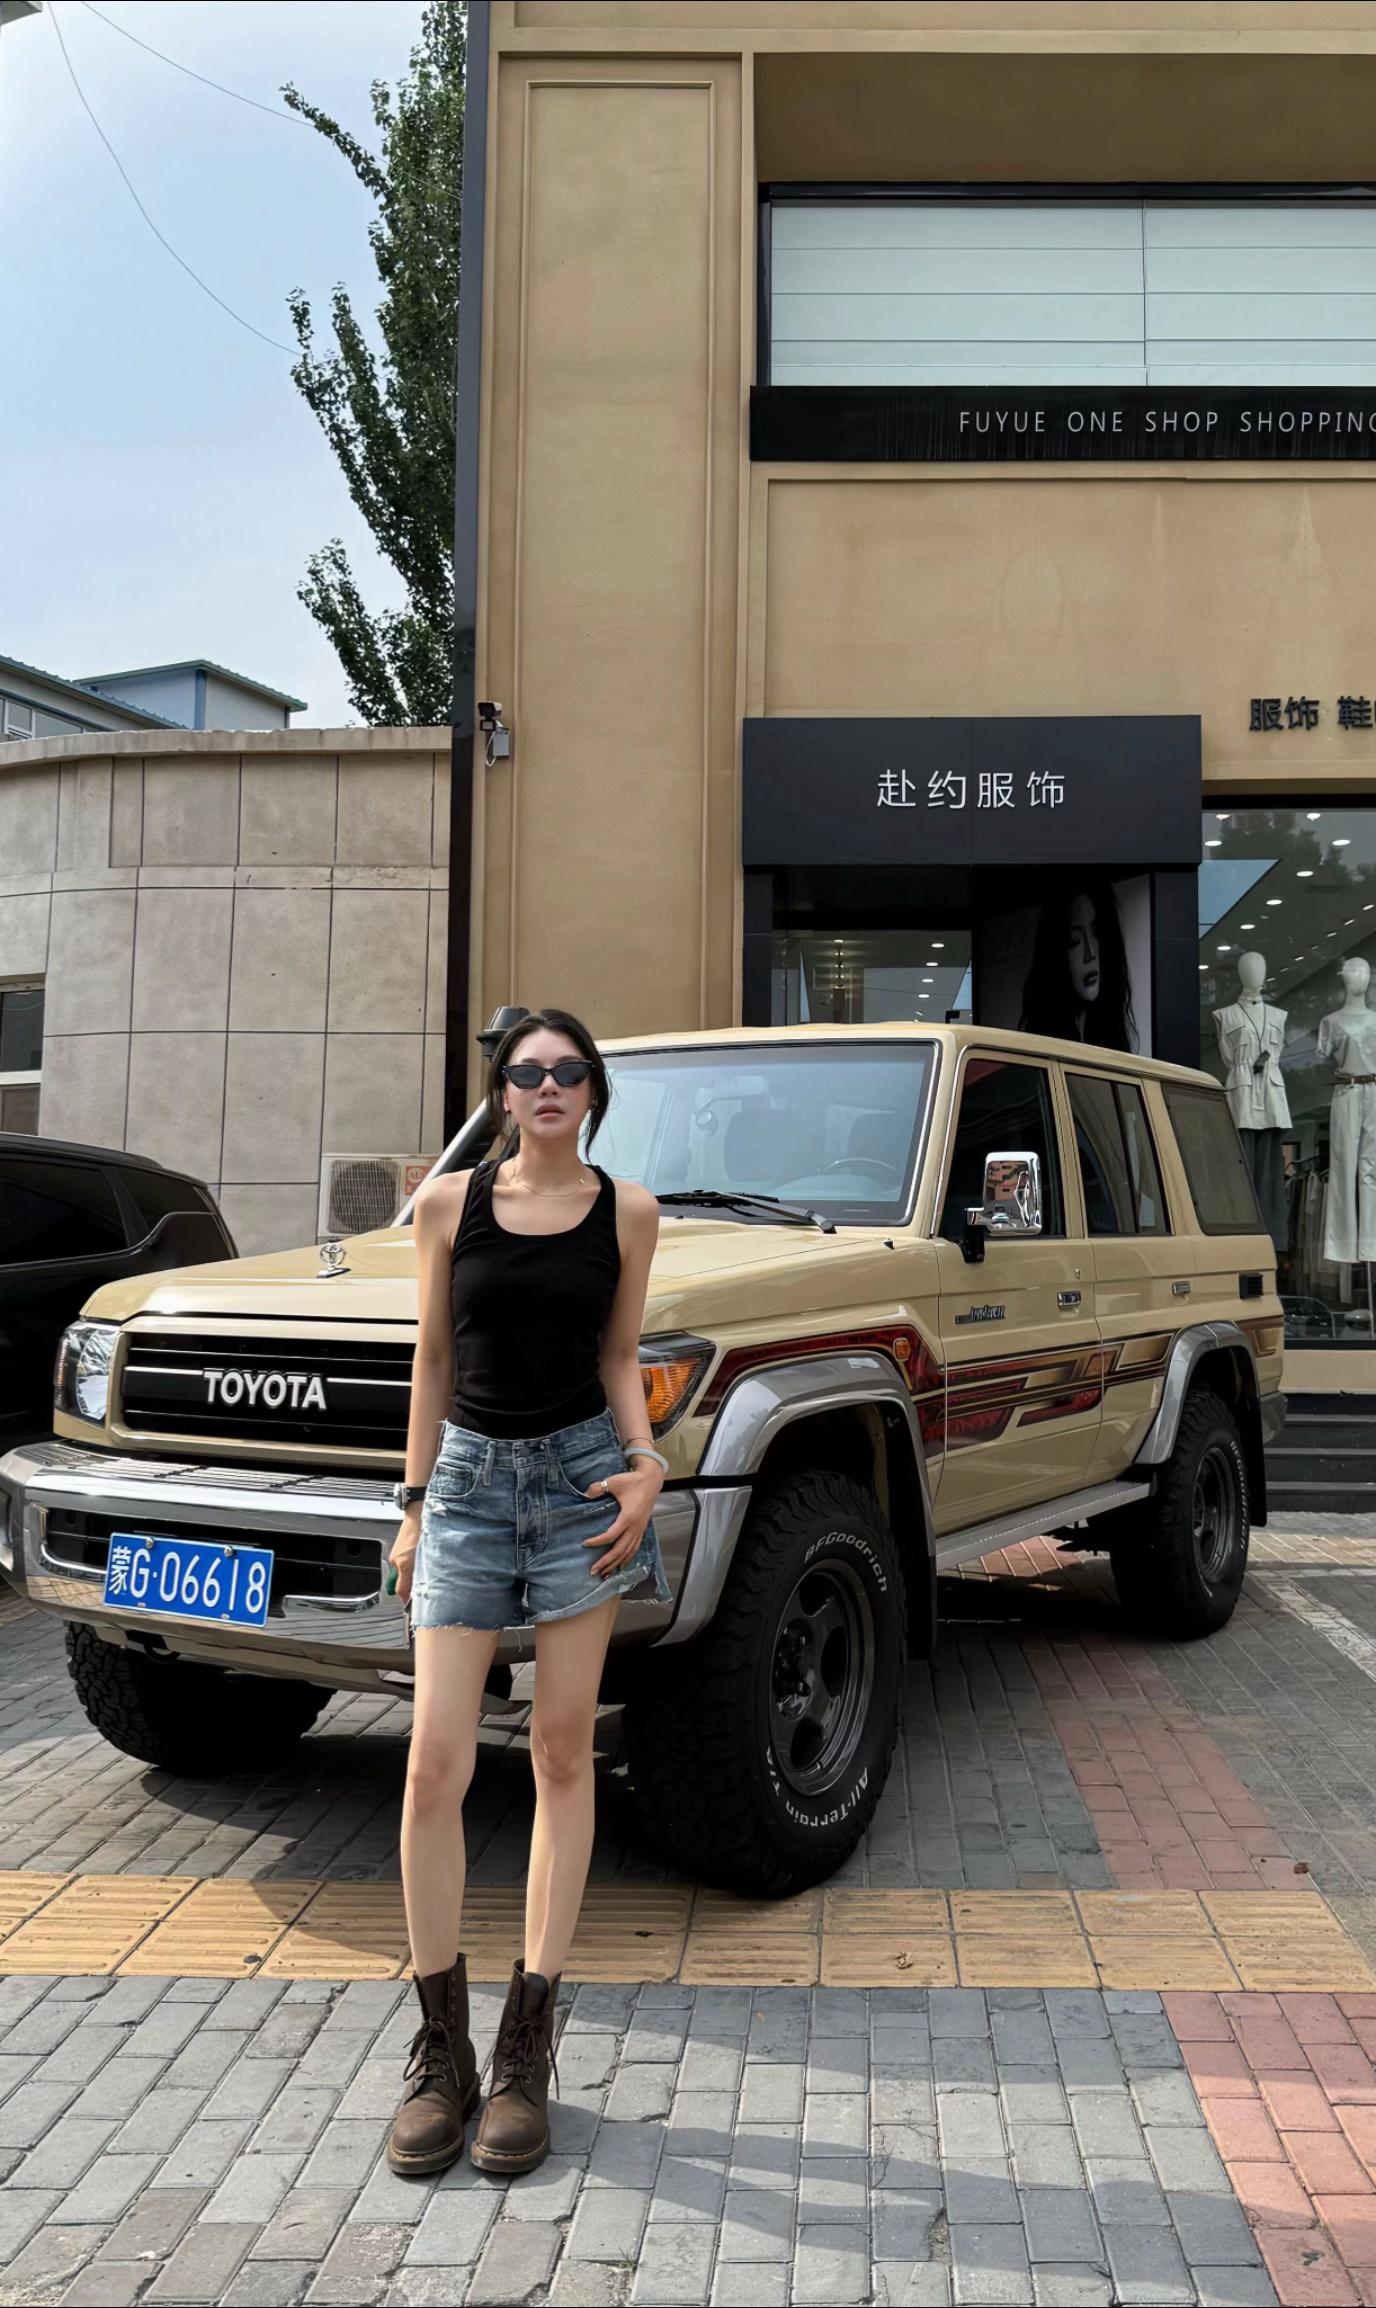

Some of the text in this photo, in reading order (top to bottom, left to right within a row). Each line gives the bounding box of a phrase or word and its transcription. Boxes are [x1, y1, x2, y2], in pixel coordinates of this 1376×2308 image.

[959, 411, 1046, 433] FUYUE
[1067, 411, 1124, 433] ONE
[1145, 411, 1220, 433] SHOP
[1249, 695, 1376, 731] 服饰 鞋
[877, 768, 1065, 809] 赴约服饰
[203, 1369, 327, 1409] TOYOTA
[804, 1531, 888, 1592] BFGoodrich
